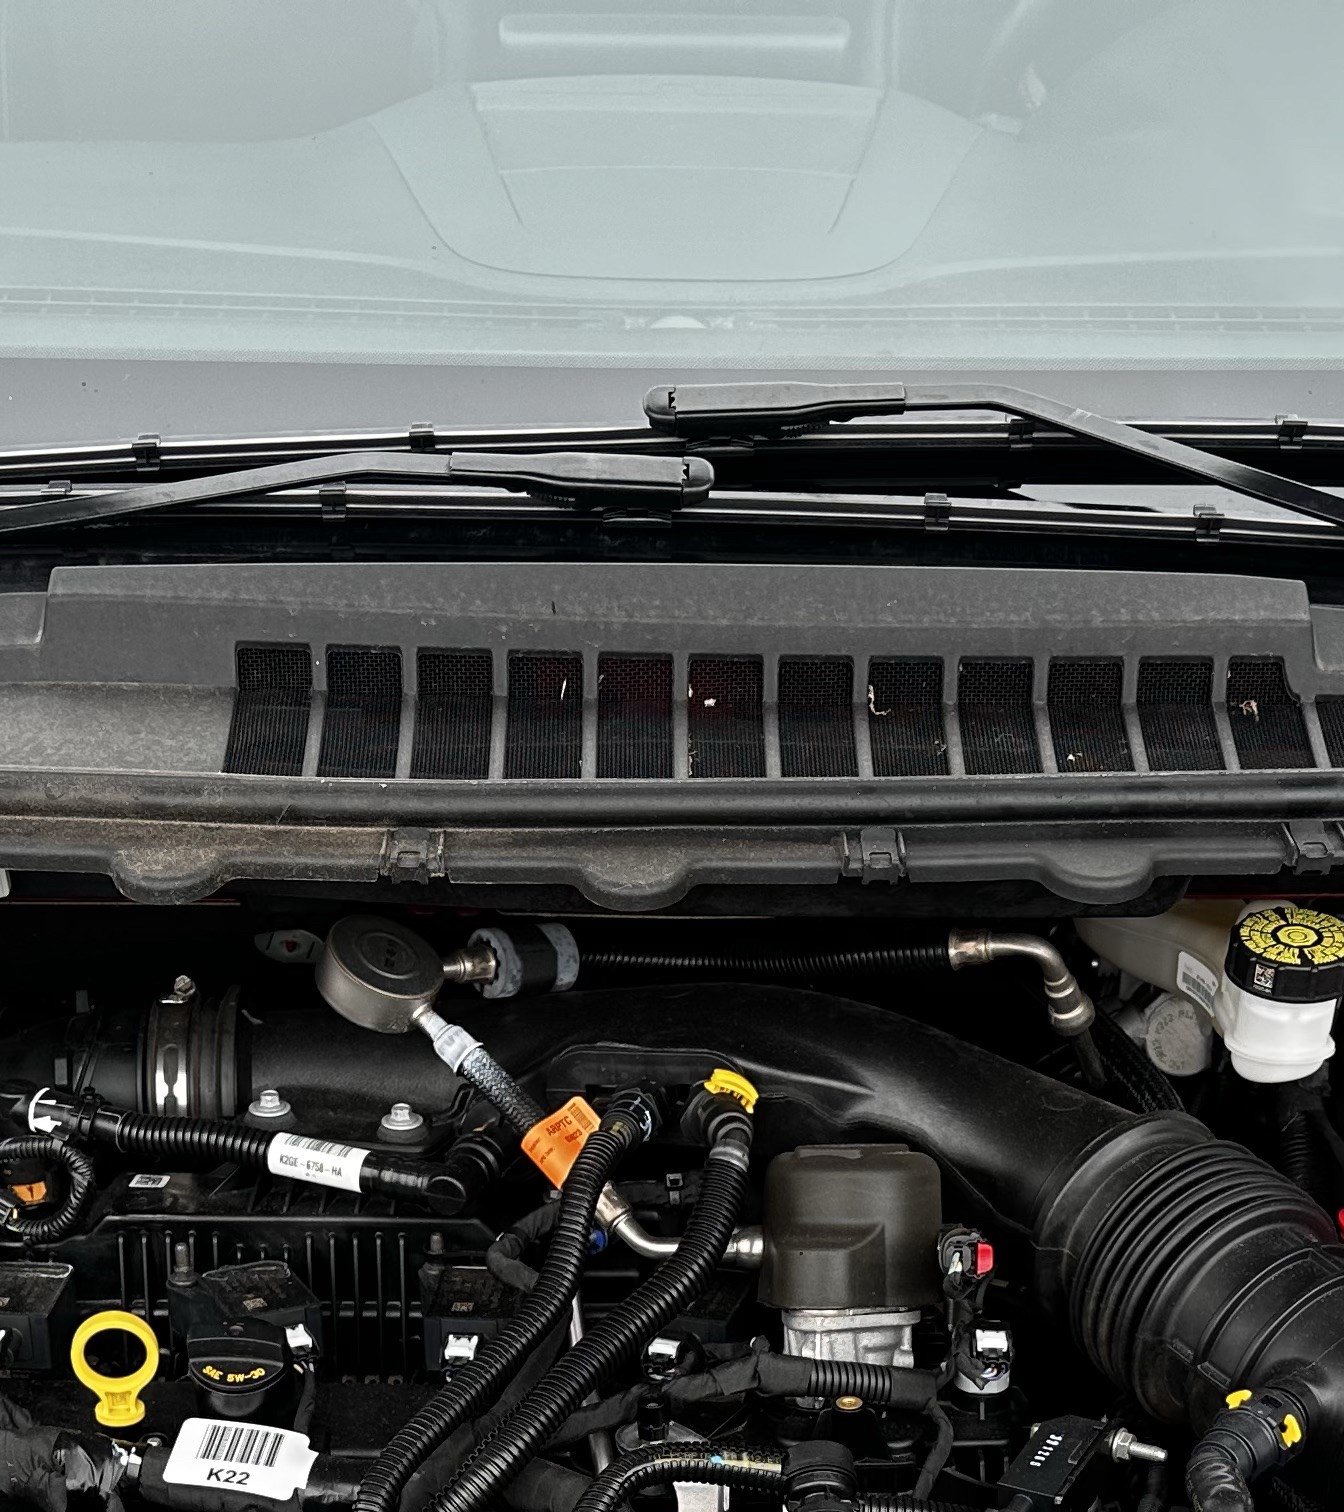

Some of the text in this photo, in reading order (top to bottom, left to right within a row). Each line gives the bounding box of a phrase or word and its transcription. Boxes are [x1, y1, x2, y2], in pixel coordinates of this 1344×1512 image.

[202, 1365, 266, 1383] SAE 5W-30
[206, 1467, 250, 1486] K22
